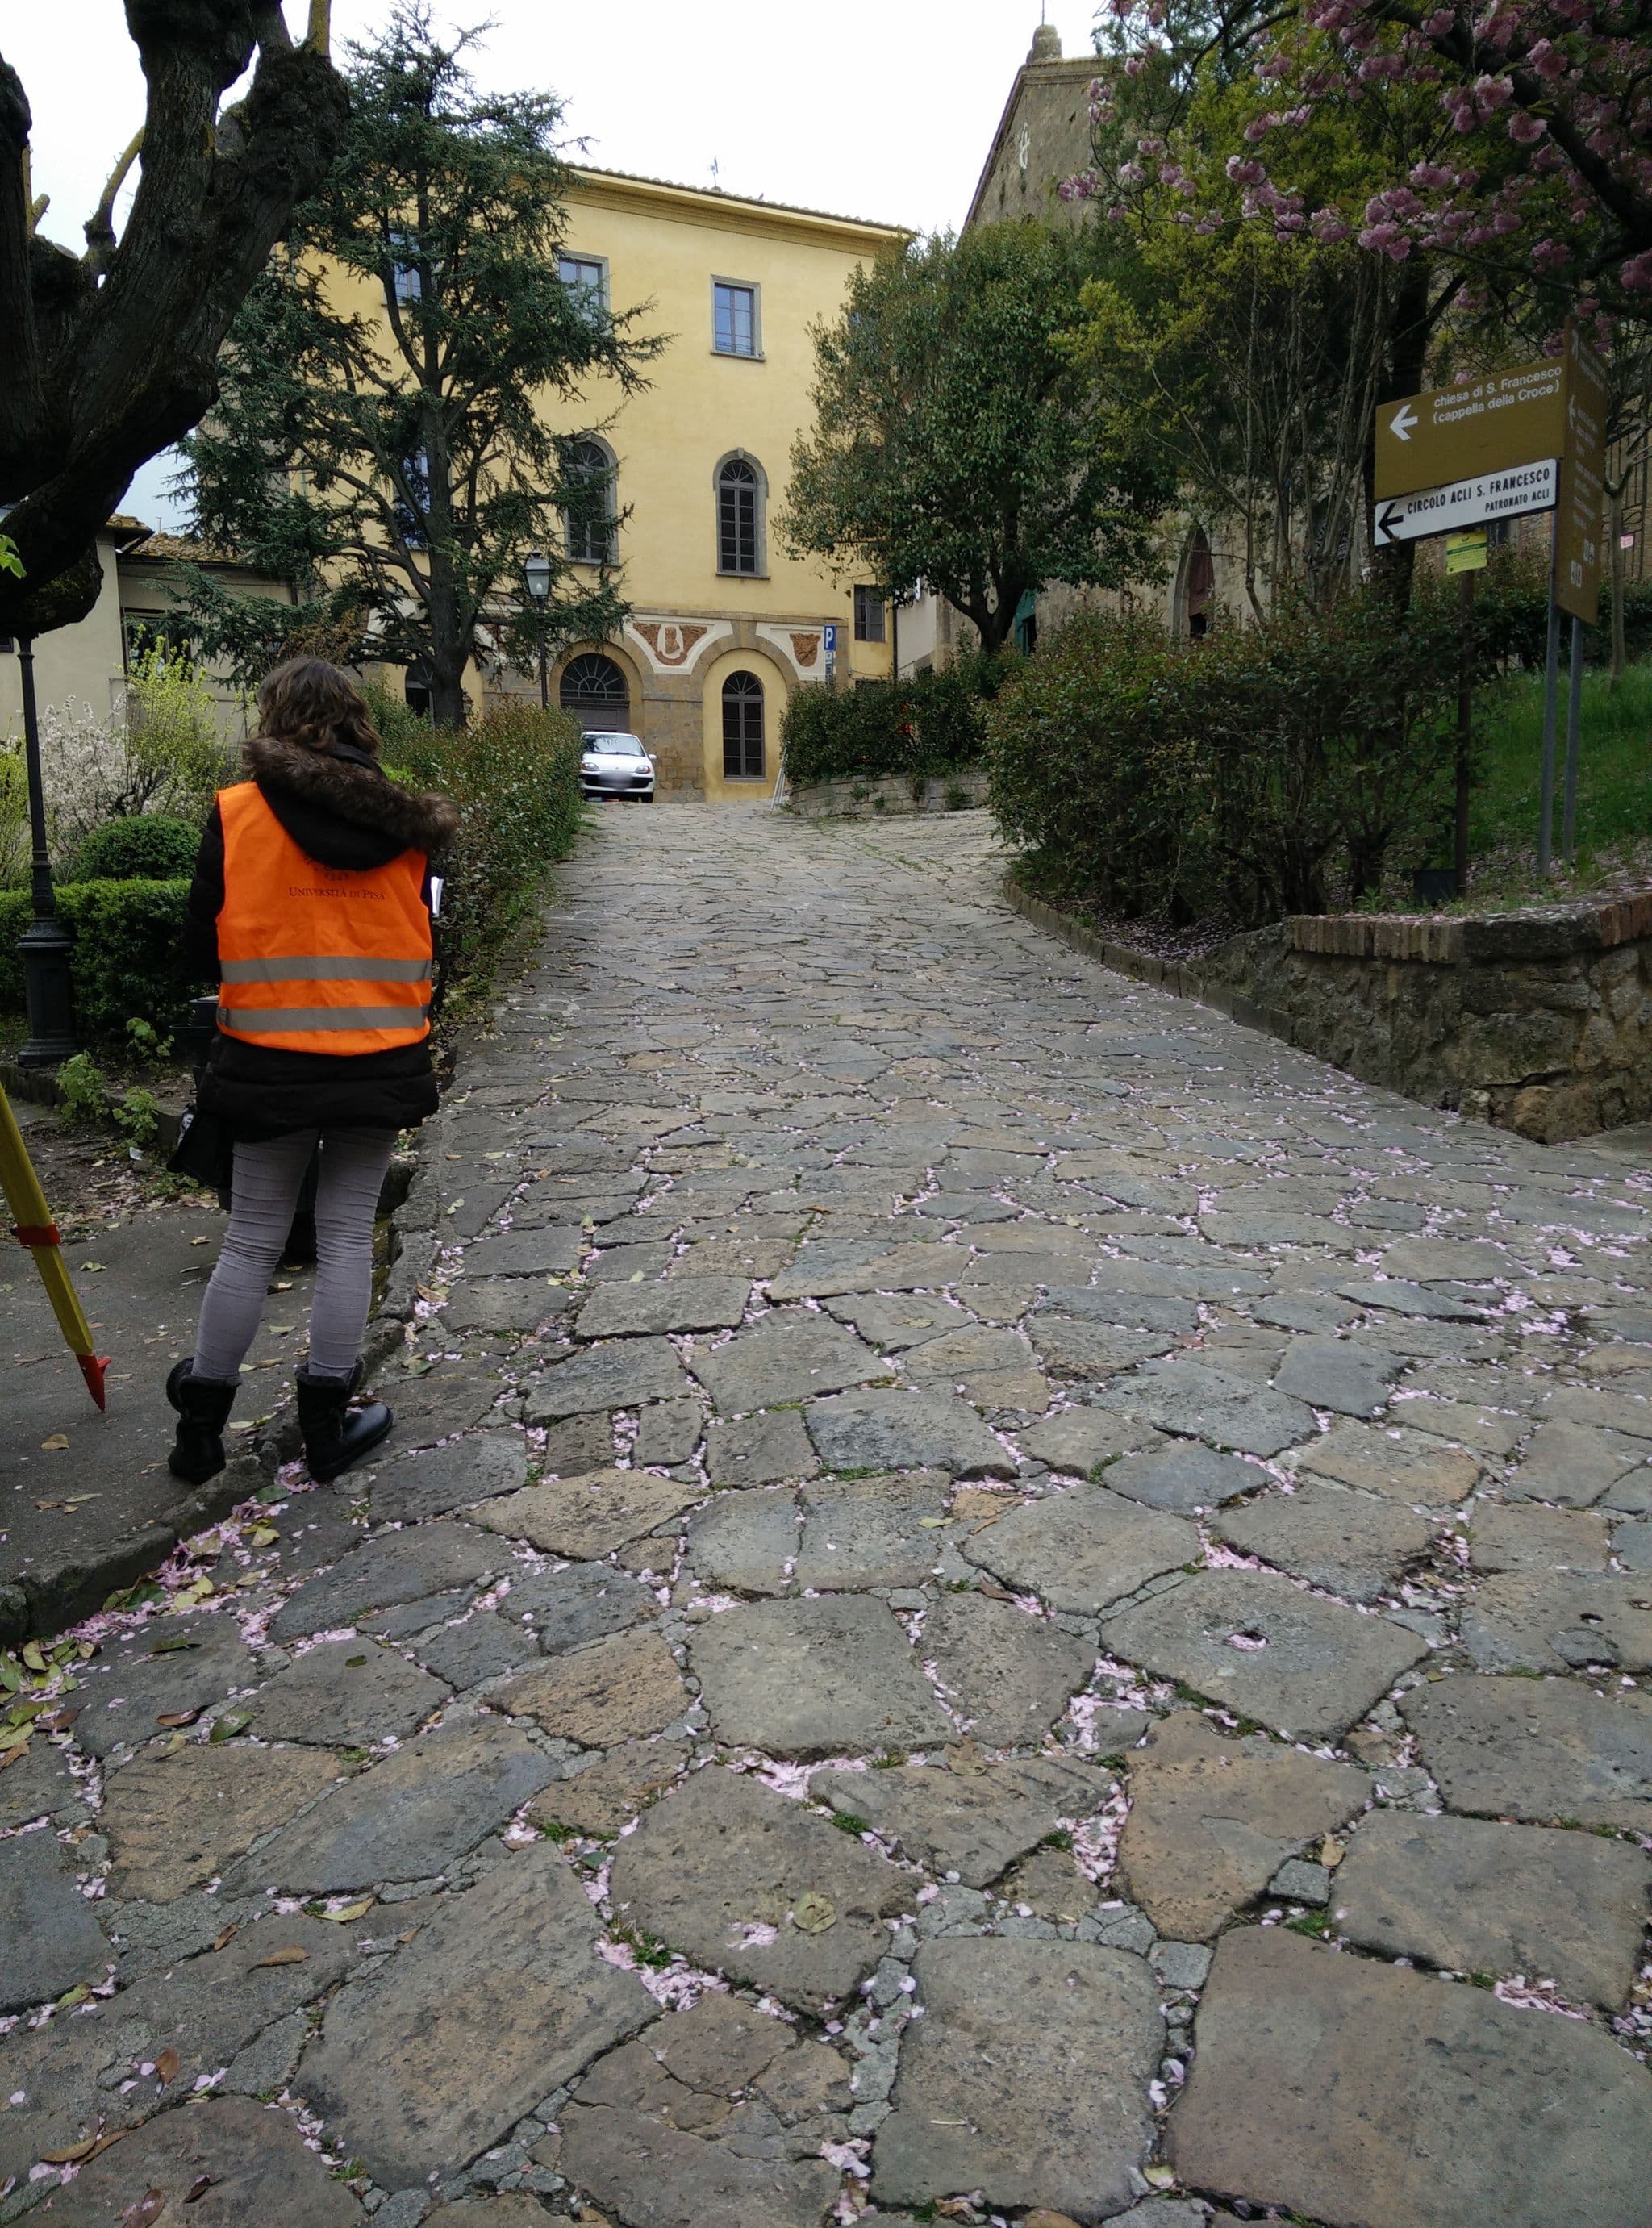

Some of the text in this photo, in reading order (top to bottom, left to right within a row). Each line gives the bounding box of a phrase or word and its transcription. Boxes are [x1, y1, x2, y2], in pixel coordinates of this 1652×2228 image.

[1433, 380, 1559, 423] (cappella della Croce)
[1434, 366, 1562, 407] chiesa di S. Francesco
[1407, 468, 1550, 515] CIRCOLO ACLI S. FRANCESCO
[1485, 488, 1550, 513] PATRONATO ACLI
[825, 628, 833, 649] P
[349, 890, 361, 898] DI
[361, 889, 385, 900] PISA
